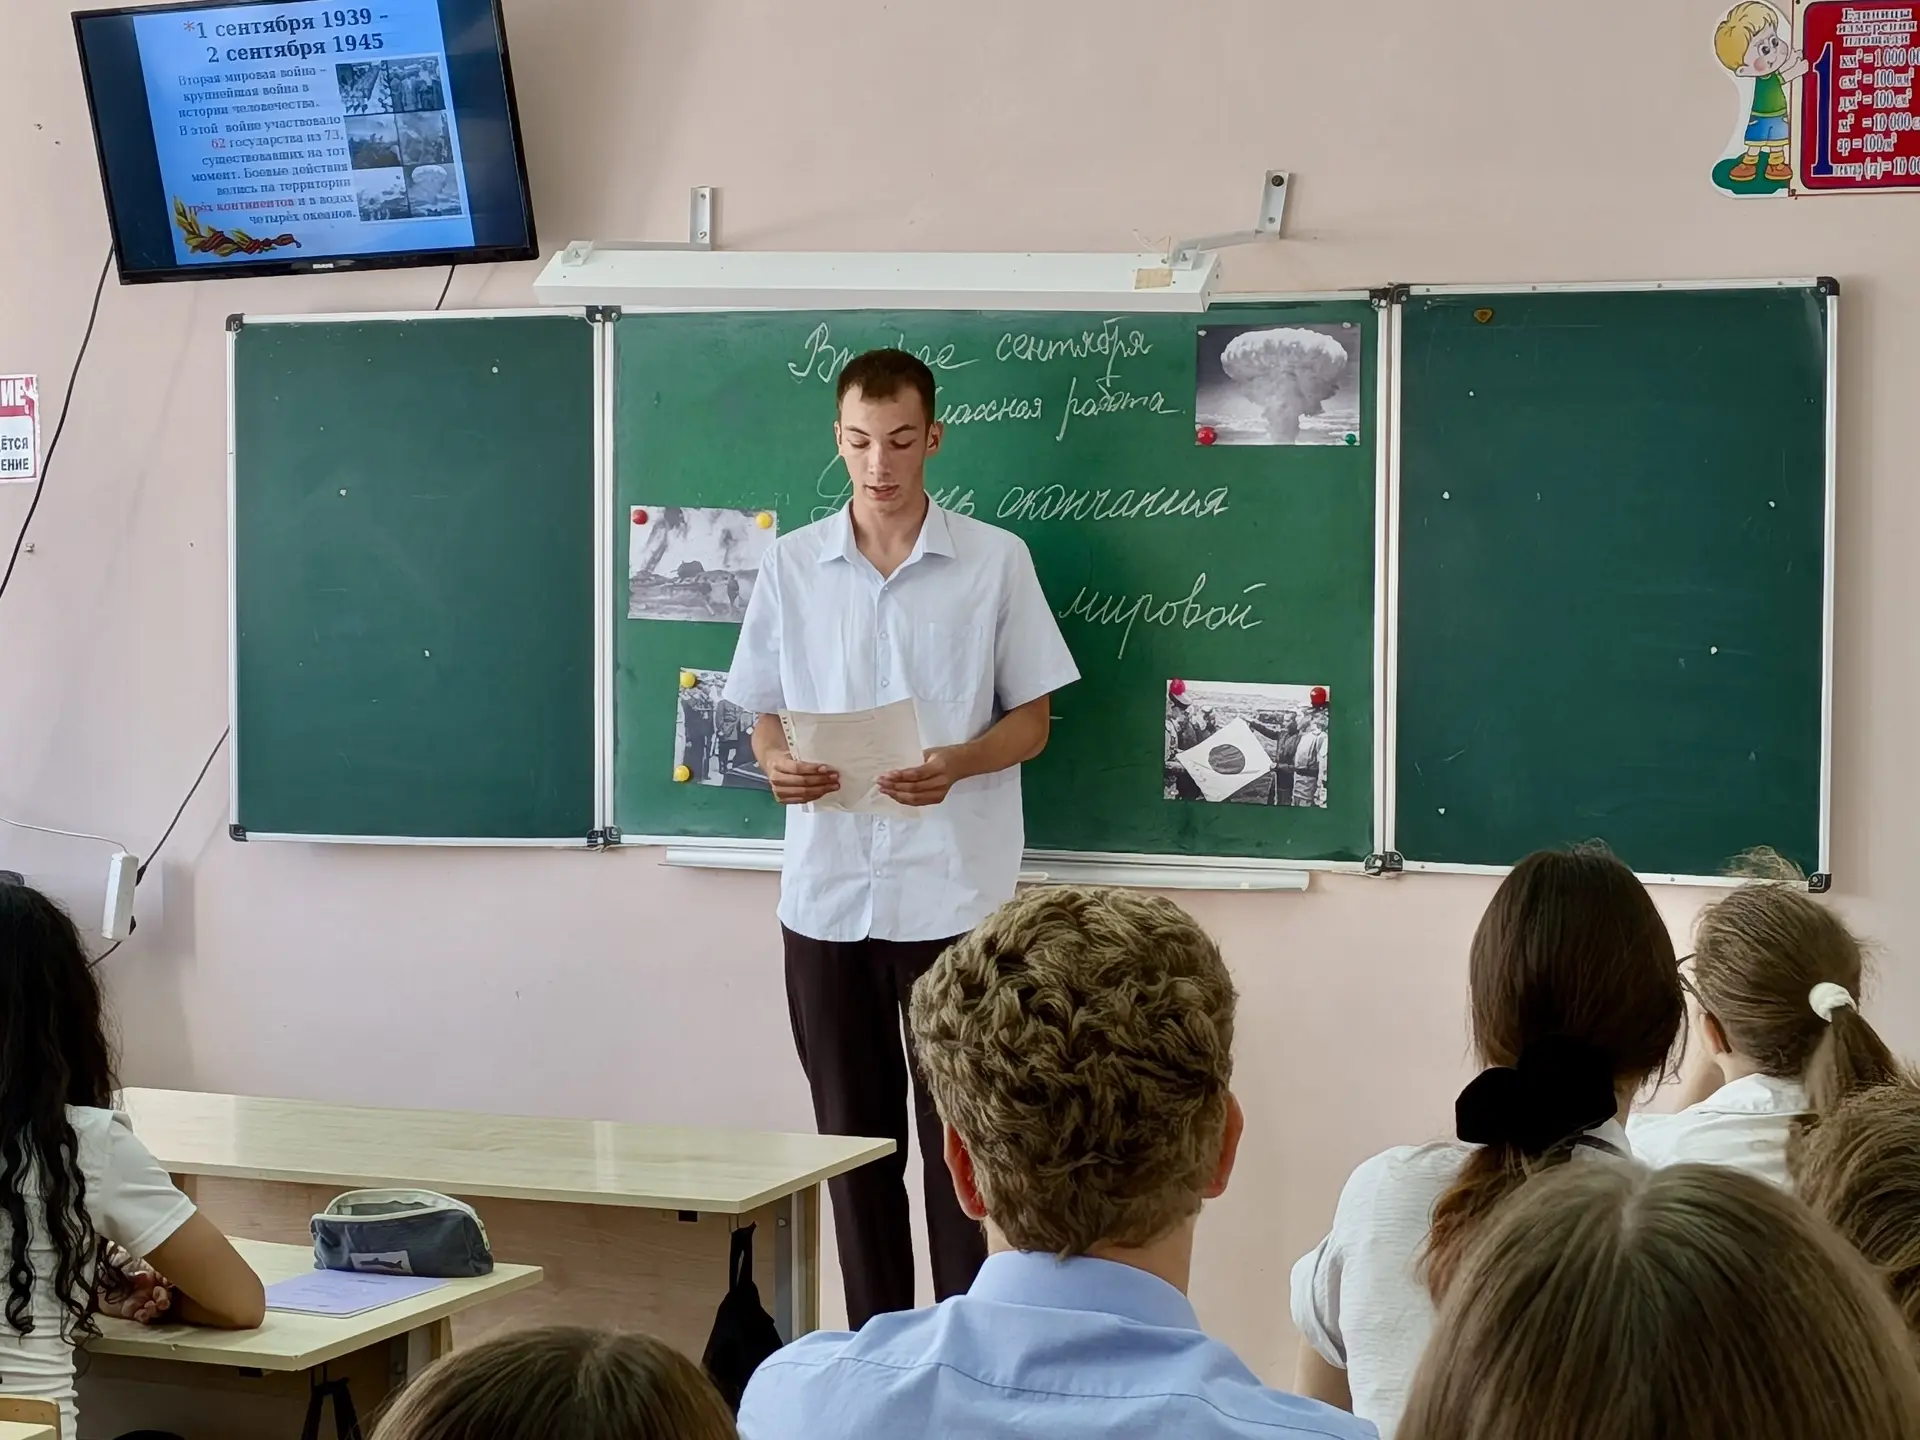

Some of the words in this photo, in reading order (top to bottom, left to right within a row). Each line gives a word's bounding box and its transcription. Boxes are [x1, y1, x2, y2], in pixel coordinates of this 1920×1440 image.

[215, 15, 316, 38] сентября
[321, 8, 372, 29] 1939
[206, 46, 220, 63] 2
[226, 40, 326, 61] сентября
[332, 33, 384, 53] 1945
[178, 73, 221, 88] Вторая
[224, 69, 276, 84] мировая
[280, 66, 316, 78] война
[183, 86, 259, 103] крупнейшая
[262, 83, 299, 95] война
[302, 84, 310, 92] в
[178, 107, 229, 119] истории
[232, 100, 320, 114] человечества.
[179, 125, 188, 136] В
[190, 123, 219, 135] этой
[225, 120, 261, 133] войне
[264, 115, 341, 132] участвовало
[211, 137, 226, 149] 62
[229, 133, 304, 149] государства
[307, 132, 321, 142] из
[202, 149, 304, 167] существовавших
[307, 149, 323, 158] на
[325, 147, 346, 157] тот
[191, 171, 241, 182] момент.
[244, 168, 288, 179] Боевые
[292, 162, 348, 176] действия
[217, 185, 258, 196] велись
[260, 184, 275, 193] на
[279, 179, 351, 194] территории
[216, 199, 294, 212] континентов
[298, 198, 306, 206] и
[309, 197, 316, 205] в
[319, 194, 354, 205] водах
[249, 212, 300, 225] четырёх
[303, 209, 357, 221] океанов.
[996, 317, 1154, 389] сентября
[934, 386, 1042, 426] лассная
[0, 434, 29, 453] ЁТСЯ
[996, 484, 1229, 521] окончания
[1058, 572, 1266, 660] мировой
